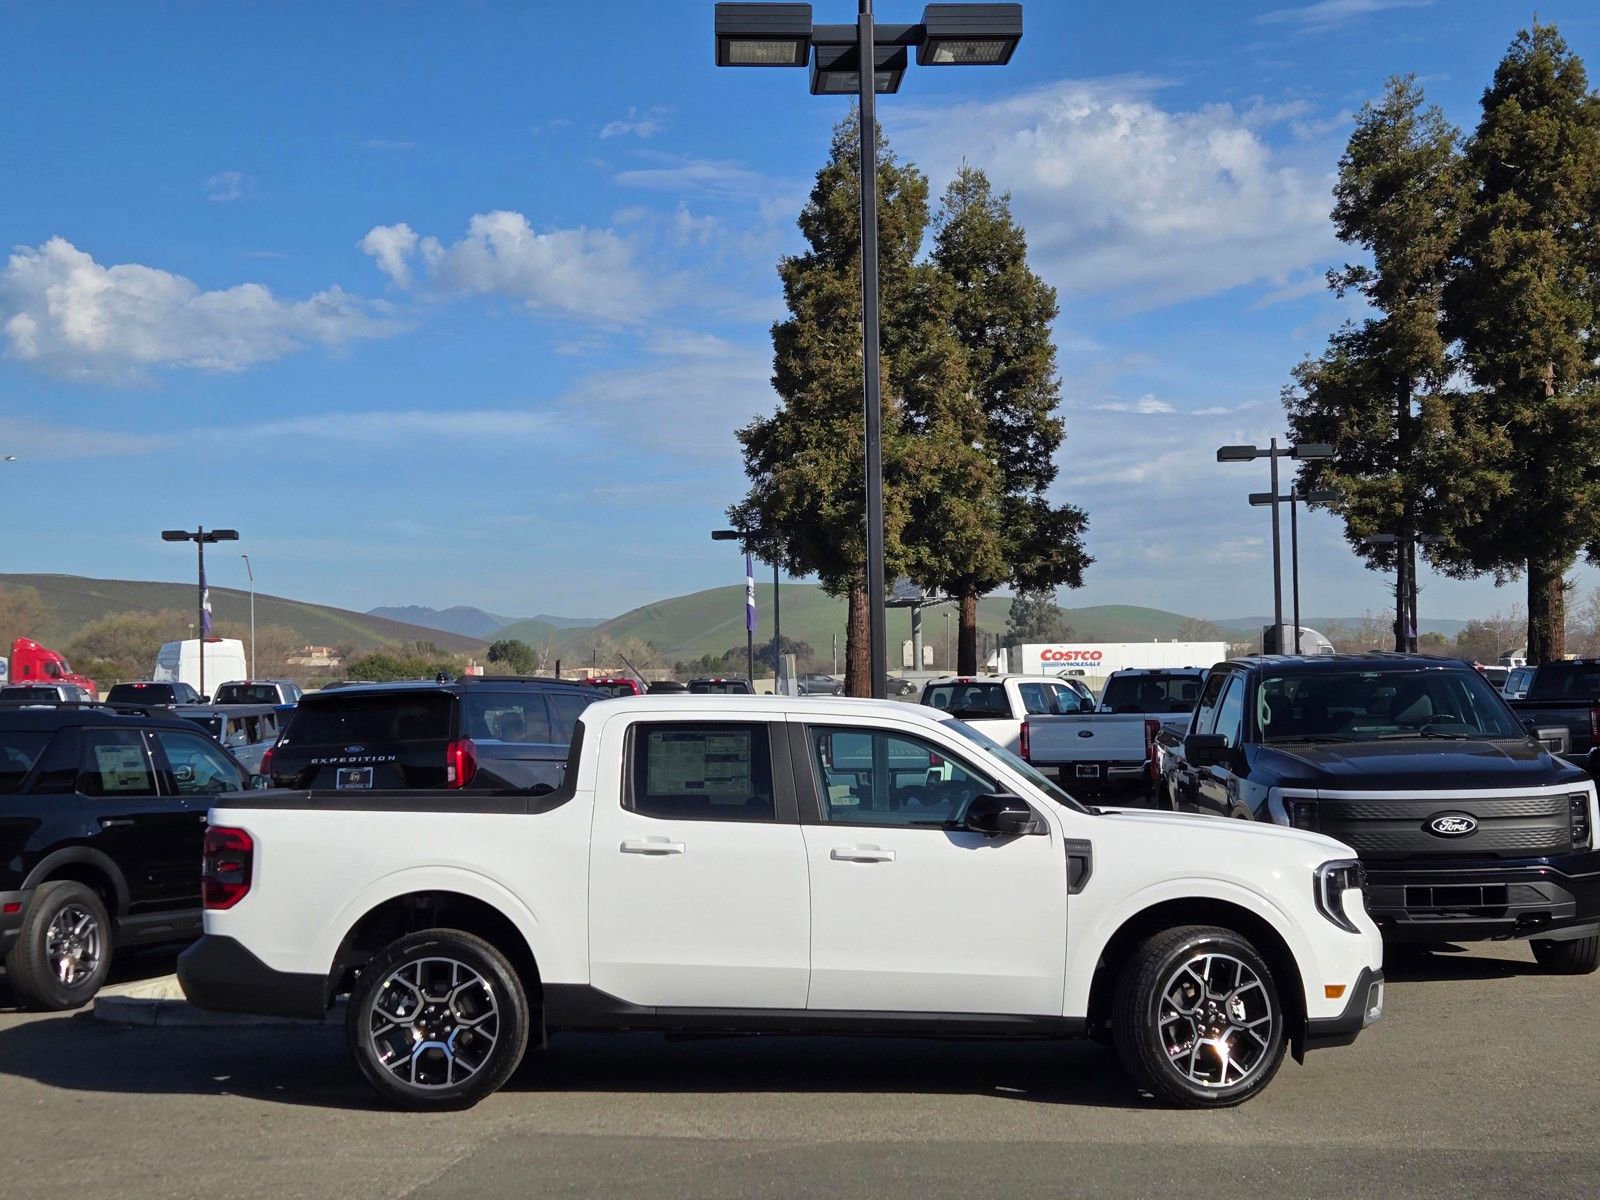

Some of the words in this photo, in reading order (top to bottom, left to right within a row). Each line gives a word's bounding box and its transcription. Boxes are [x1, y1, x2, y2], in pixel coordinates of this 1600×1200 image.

[1040, 649, 1103, 661] COSTCO
[311, 755, 396, 764] EXPEDITION
[1439, 819, 1468, 831] Ford
